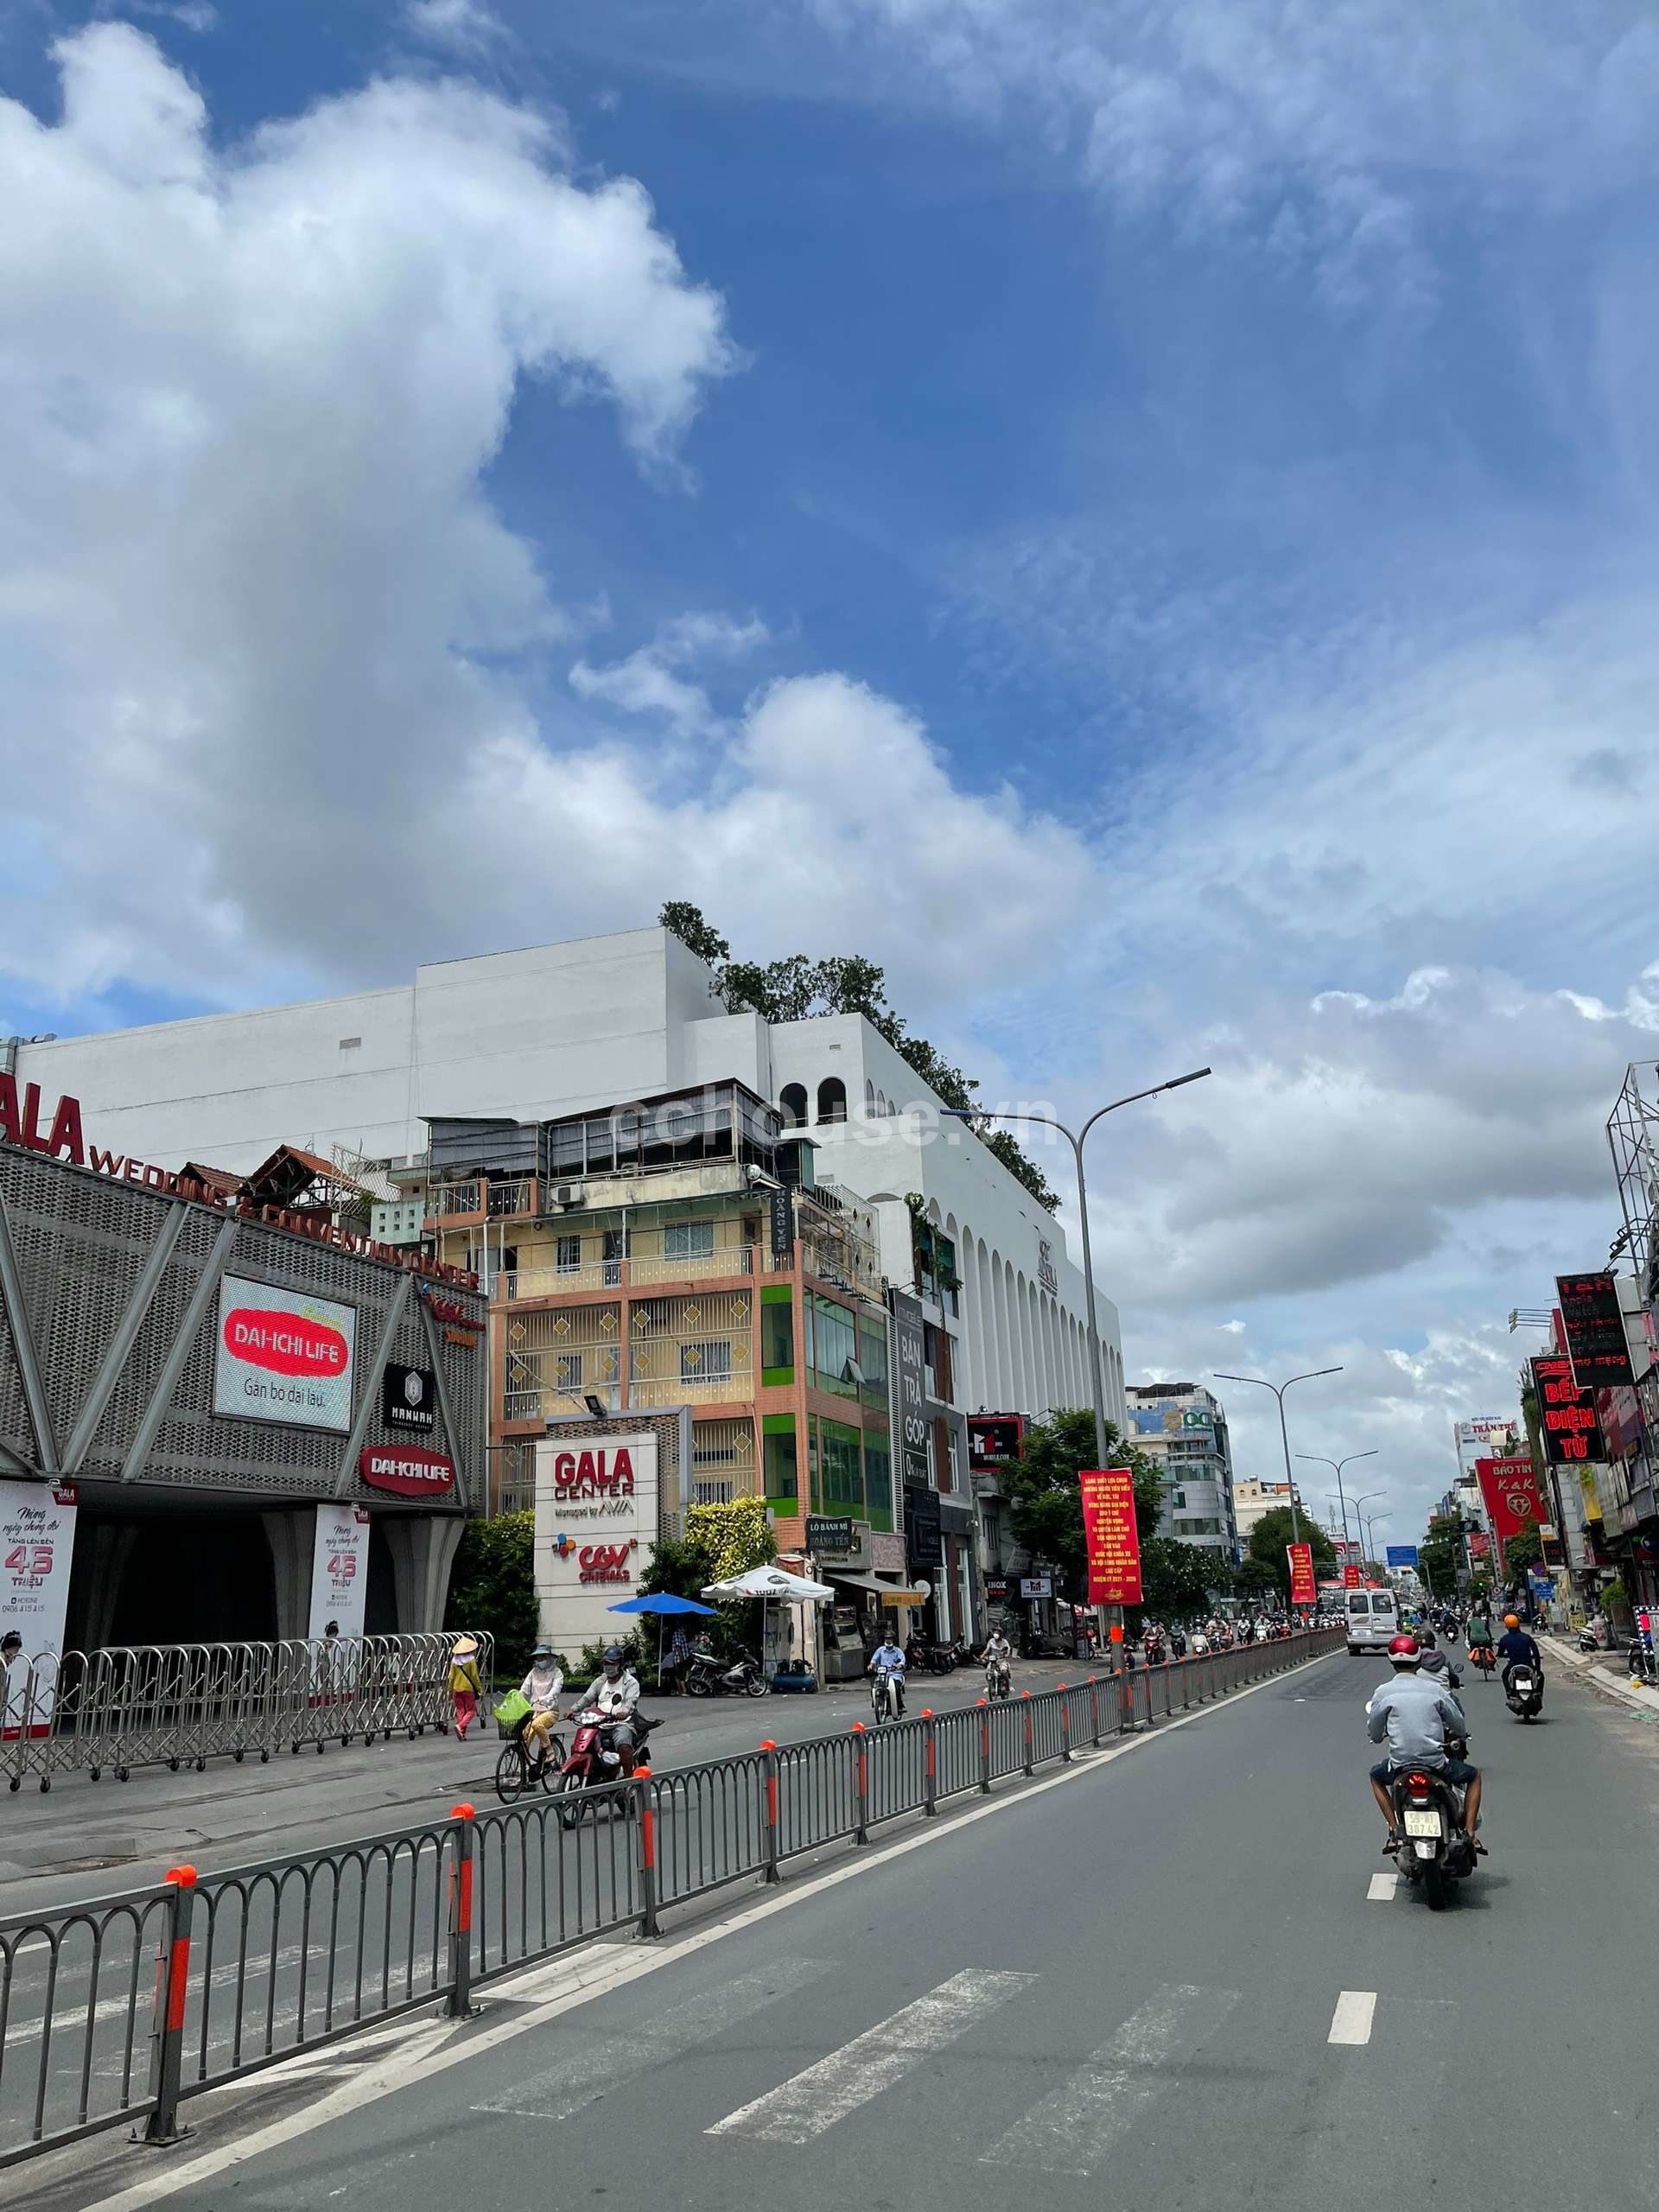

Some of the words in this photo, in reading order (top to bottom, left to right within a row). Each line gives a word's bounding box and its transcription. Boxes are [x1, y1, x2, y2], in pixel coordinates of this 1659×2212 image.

[90, 1145, 228, 1211] WEDDING
[263, 1204, 404, 1265] CONVENTION
[305, 1340, 340, 1363] LIFE
[901, 1332, 921, 1369] BÁN
[391, 1406, 433, 1425] MANWAH
[1545, 1405, 1596, 1433] ĐIỆN
[905, 1410, 925, 1446] GÓP
[423, 1464, 450, 1482] LIFE
[555, 1448, 635, 1486] GALA
[554, 1483, 635, 1501] CENTER
[1497, 1479, 1509, 1490] K
[1511, 1481, 1521, 1490] &
[1522, 1478, 1534, 1490] K
[555, 1506, 588, 1519] Managed
[589, 1506, 598, 1518] by
[579, 1545, 630, 1571] CGV
[579, 1570, 631, 1583] CINEMAS
[988, 1580, 1007, 1589] INOX
